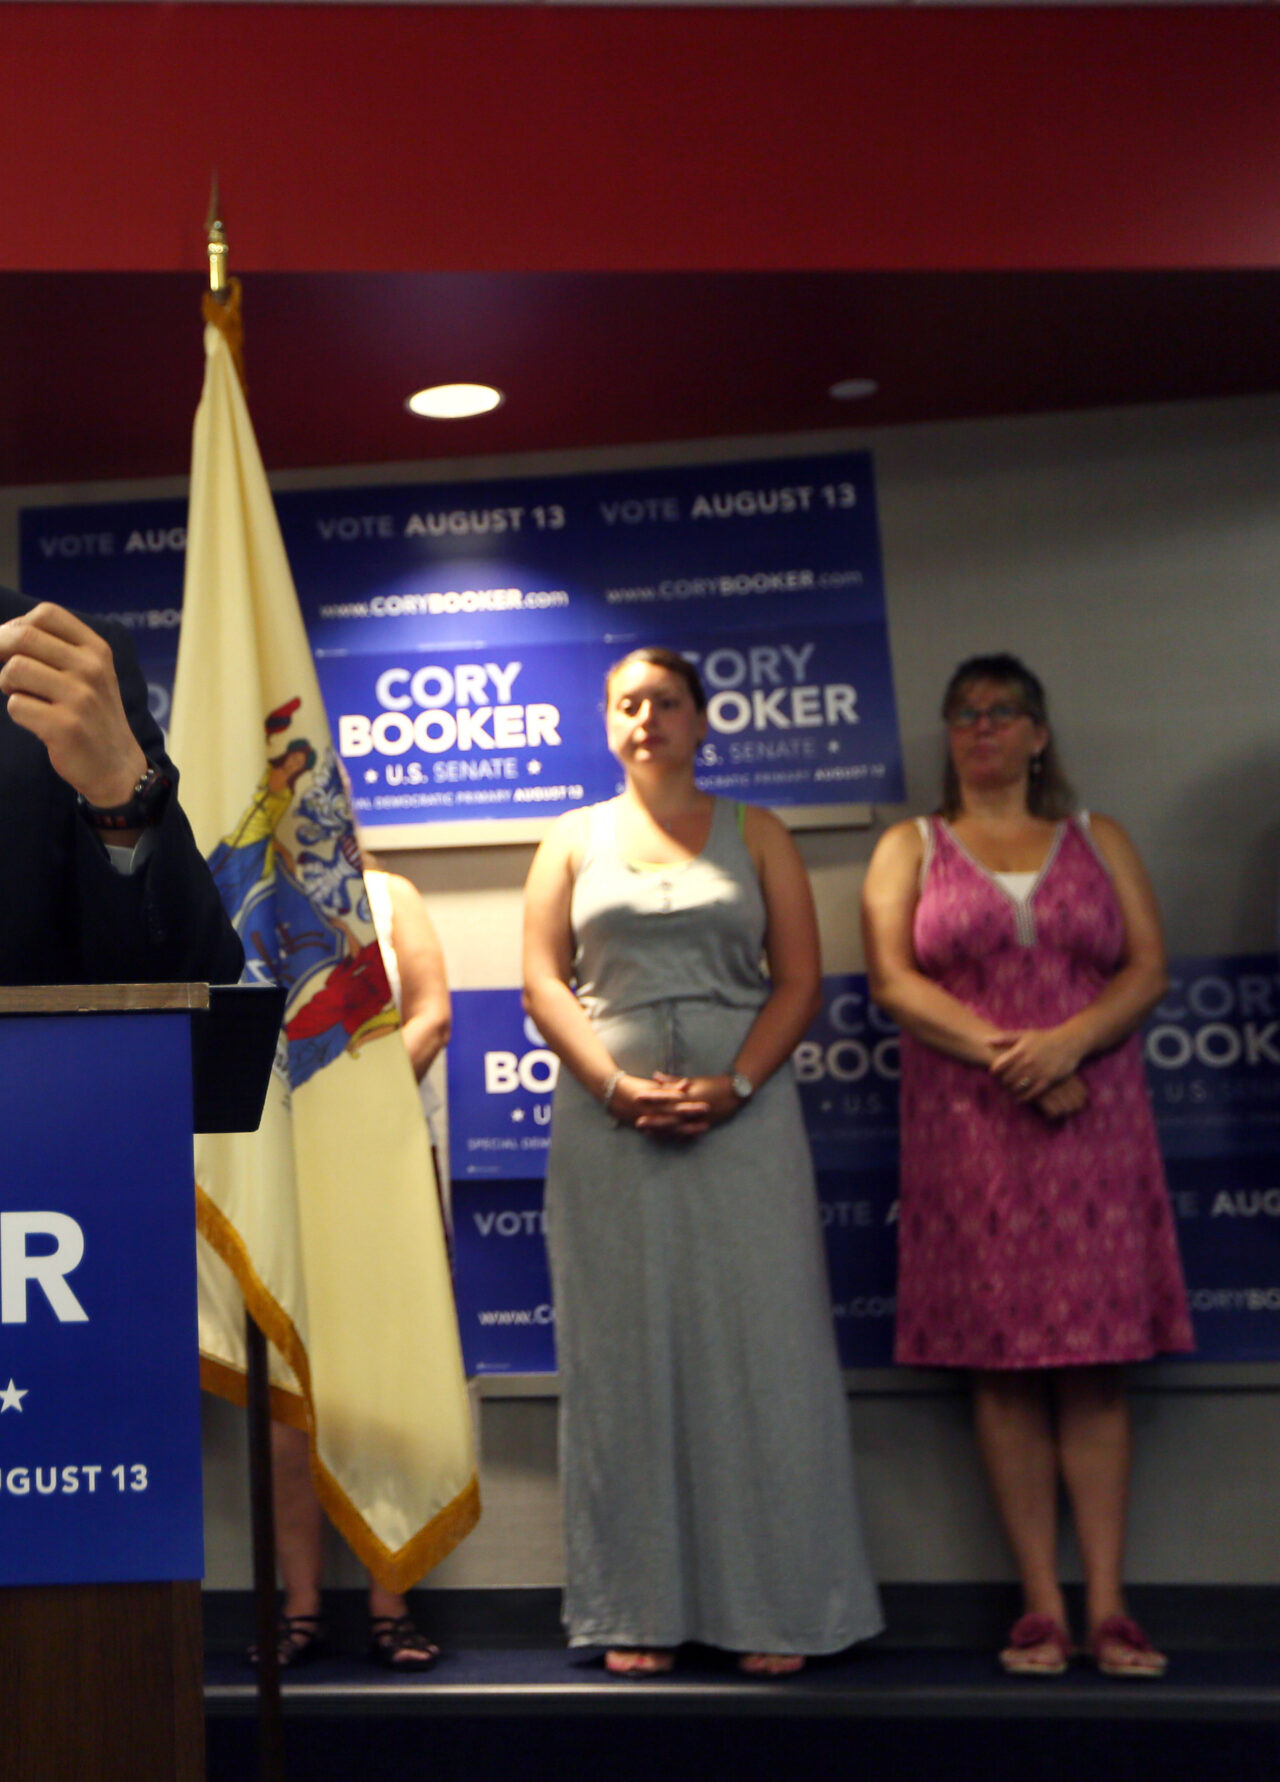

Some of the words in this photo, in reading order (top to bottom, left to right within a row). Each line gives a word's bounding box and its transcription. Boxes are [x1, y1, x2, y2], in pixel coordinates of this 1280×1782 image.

[599, 497, 679, 525] VOTE
[690, 486, 813, 520] AUGUST
[821, 482, 856, 510] 13
[318, 515, 393, 540] VOTE
[404, 507, 523, 537] AUGUST
[532, 505, 566, 530] 13
[38, 532, 115, 558] VOTE
[123, 527, 187, 554] AUG
[681, 642, 816, 690] ORY
[376, 661, 522, 711] CORY
[706, 683, 860, 734] OKER
[338, 703, 562, 758] BOOKER
[729, 736, 816, 764] SENATE
[385, 762, 429, 787] U.S.
[433, 757, 519, 784] SENATE
[793, 1035, 901, 1083] BOO
[821, 1200, 872, 1227] OTE
[1210, 1186, 1280, 1218] AUG
[111, 1464, 150, 1494] 13
